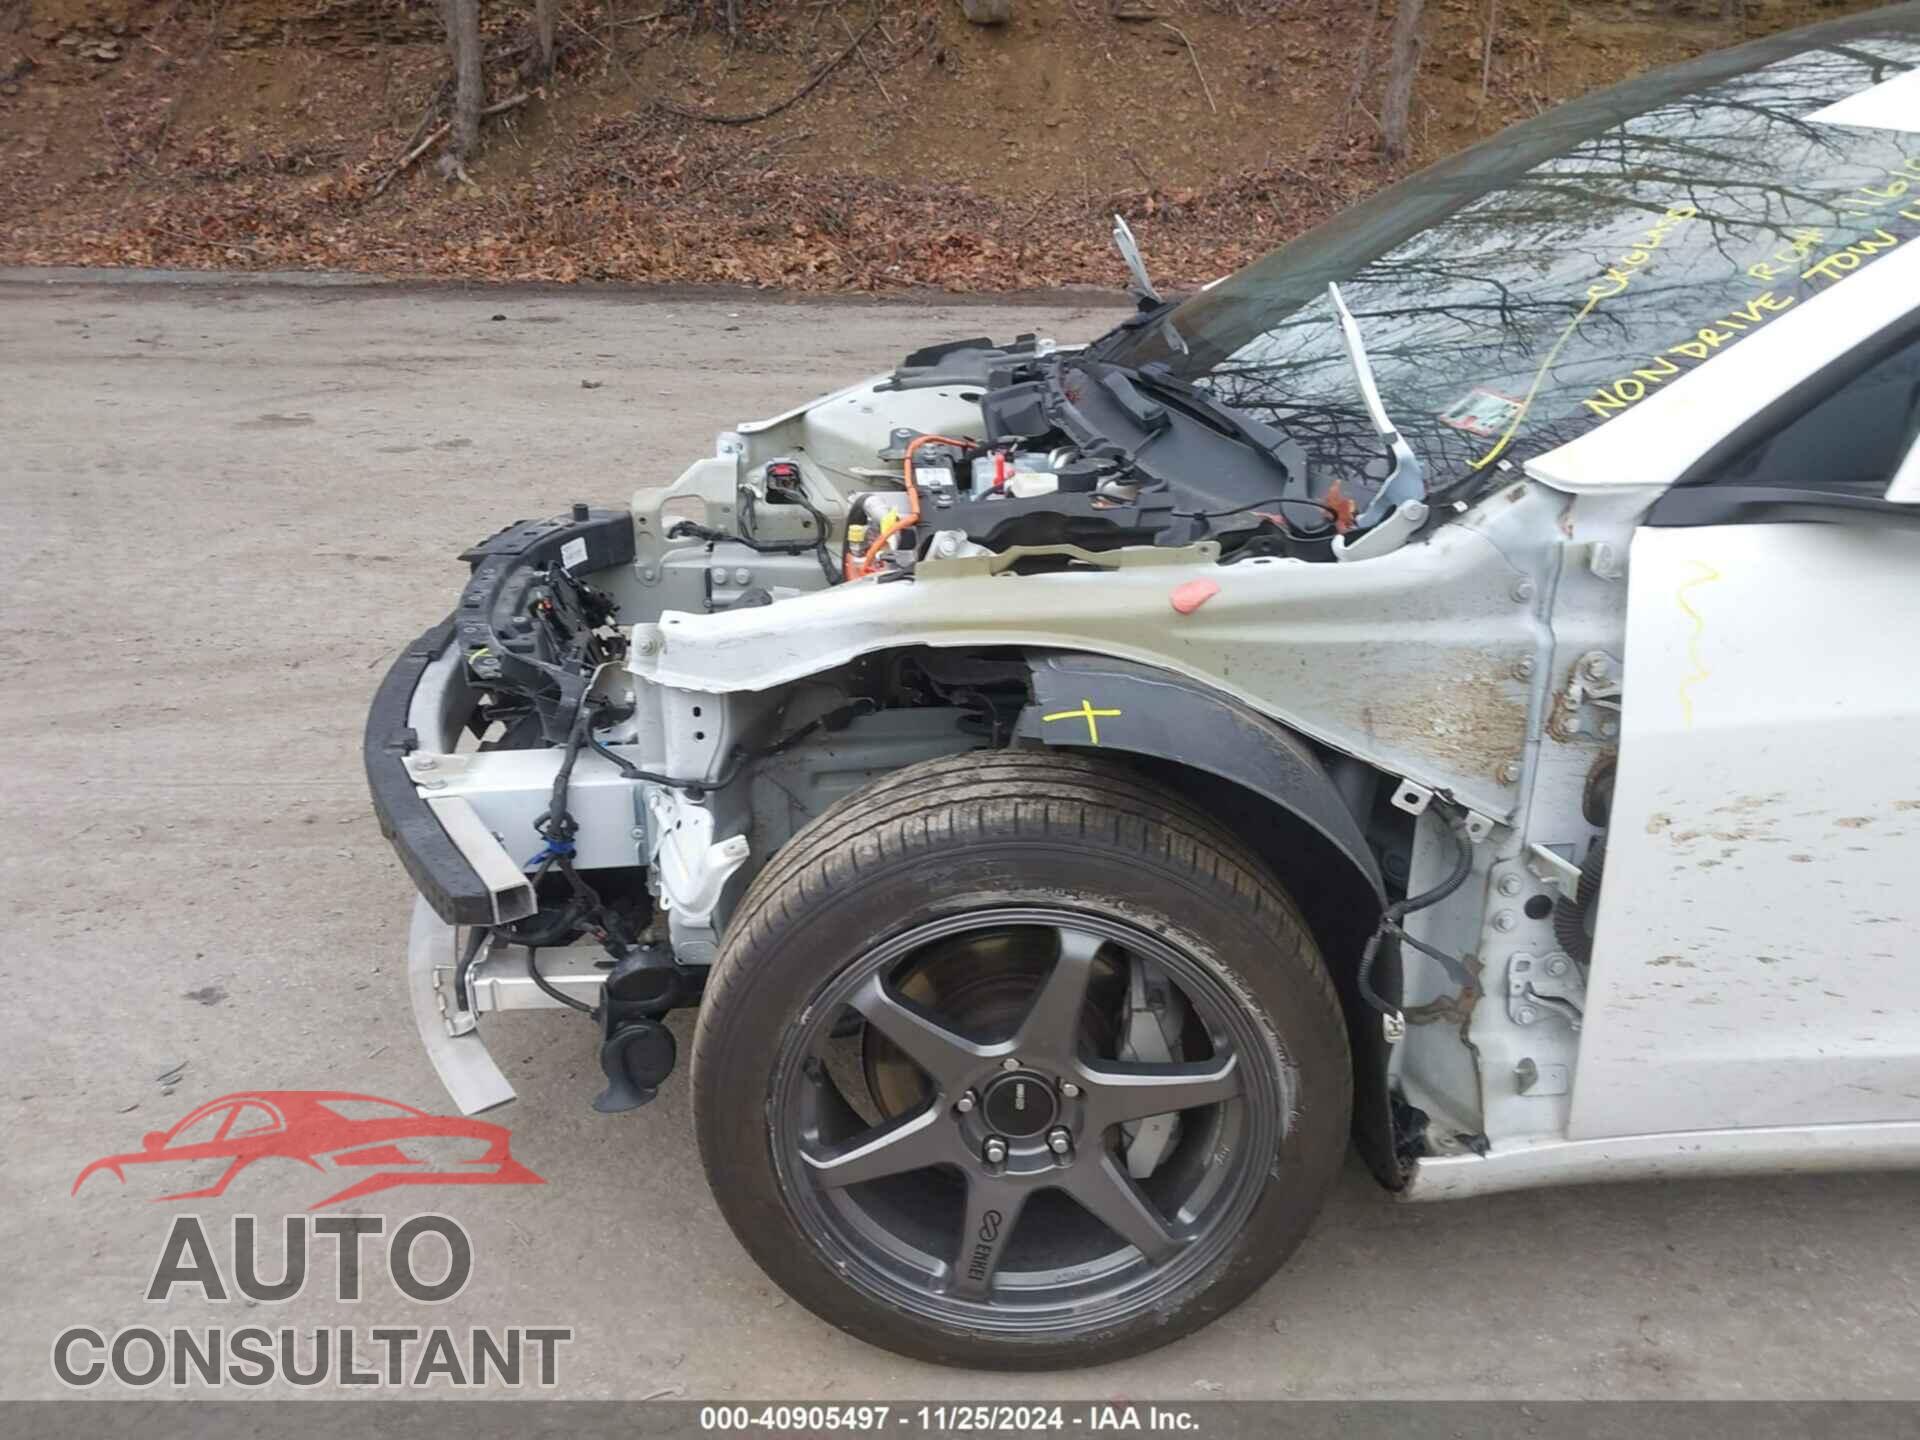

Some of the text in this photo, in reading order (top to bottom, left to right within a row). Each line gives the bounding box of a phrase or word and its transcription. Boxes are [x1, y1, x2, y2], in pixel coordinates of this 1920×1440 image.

[1583, 227, 1899, 418] NON DRIVE TOW
